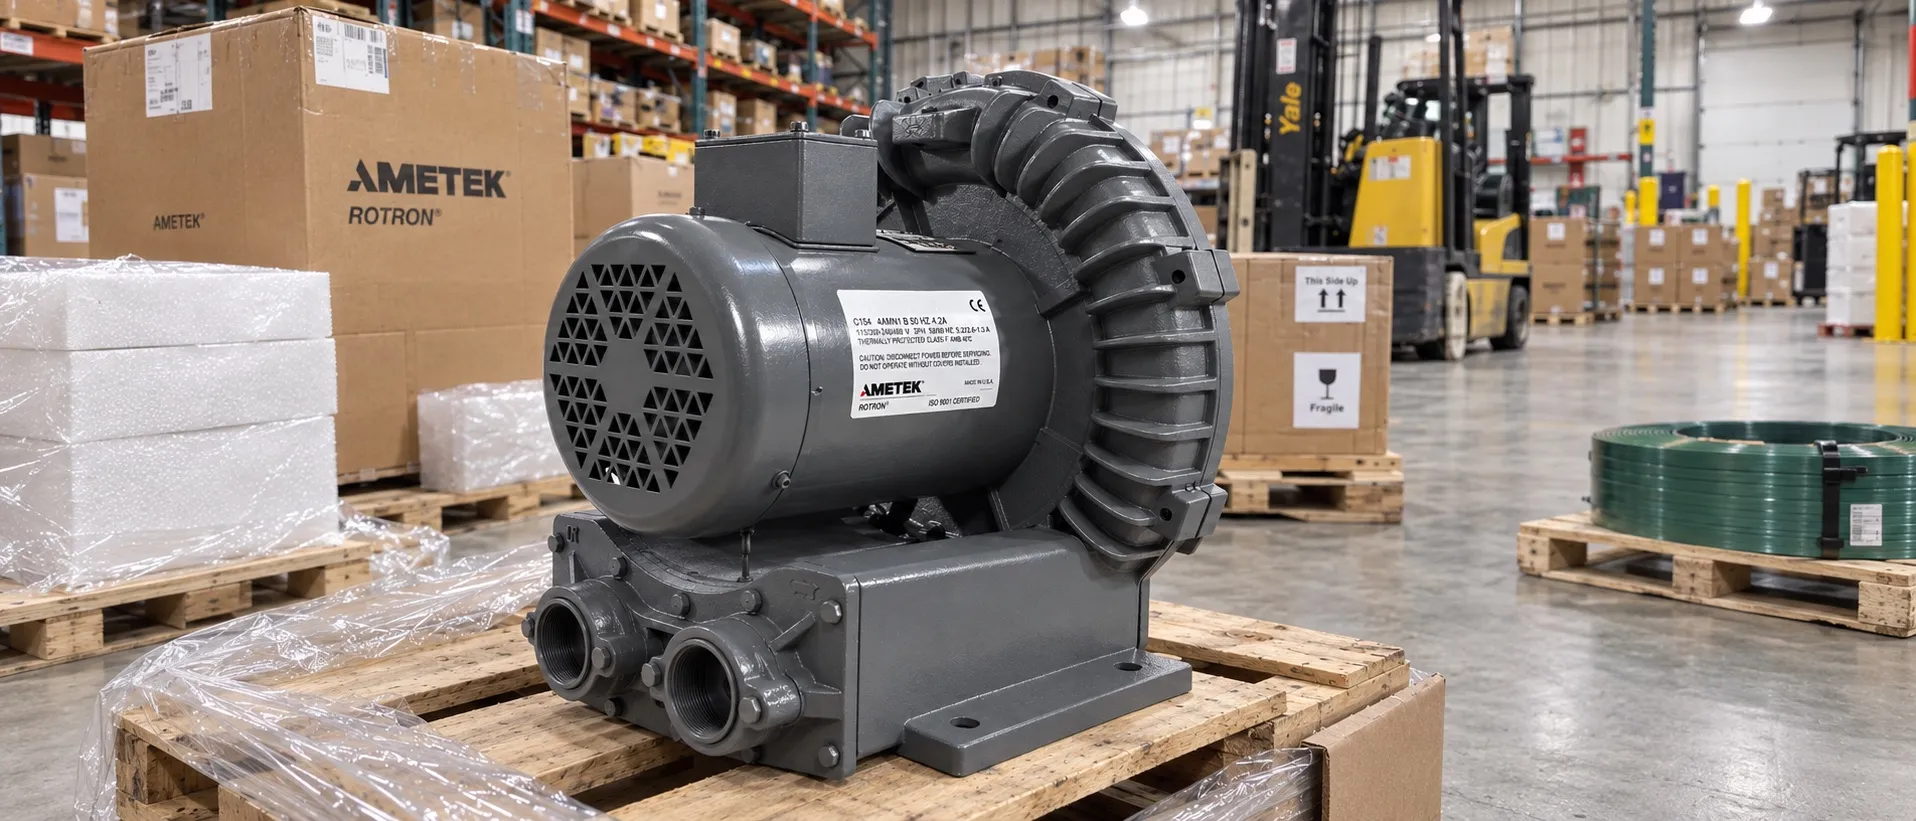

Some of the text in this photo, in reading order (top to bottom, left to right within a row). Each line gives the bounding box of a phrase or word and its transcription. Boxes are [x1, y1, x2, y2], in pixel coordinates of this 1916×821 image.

[1280, 82, 1302, 135] Yale
[348, 206, 442, 226] ROTRON®
[1305, 276, 1358, 286] This Side Up
[928, 396, 981, 407] ISO 9001 CERTIFIED
[1310, 403, 1344, 414] Fragile
